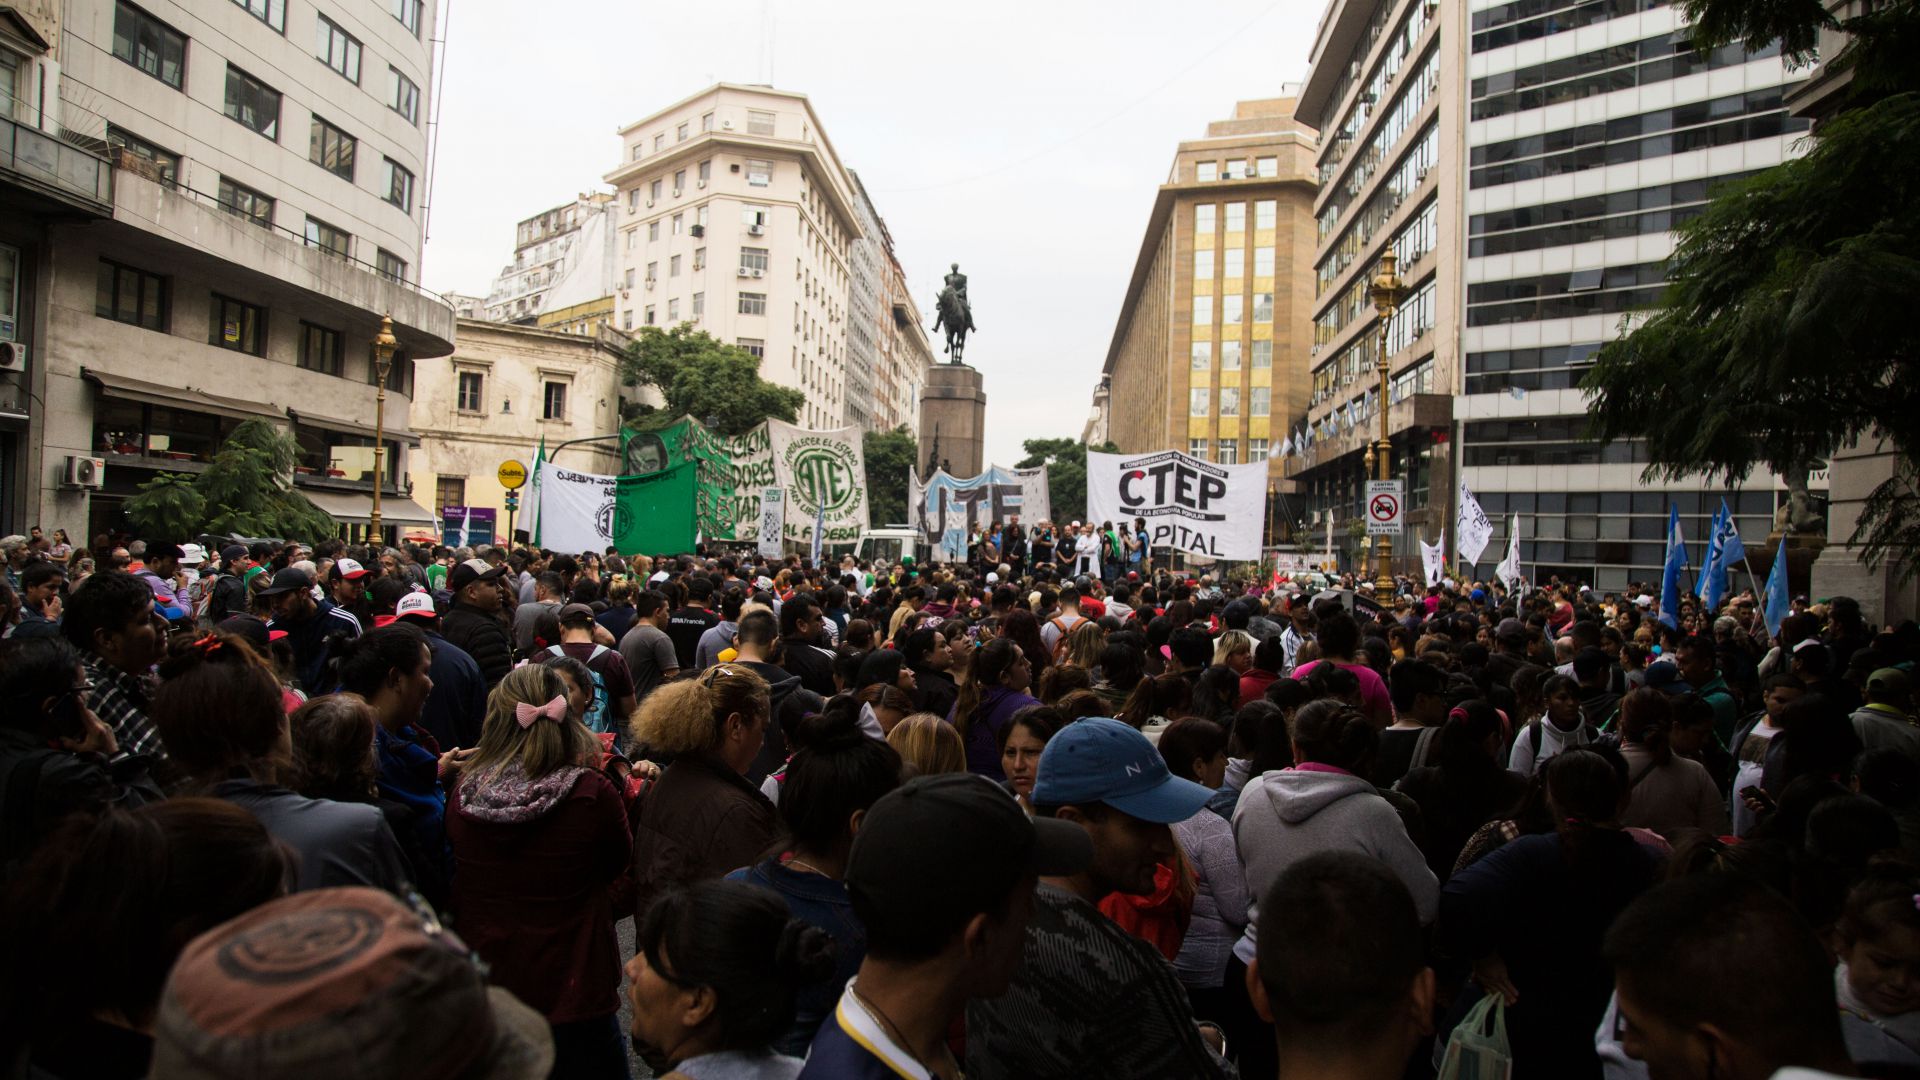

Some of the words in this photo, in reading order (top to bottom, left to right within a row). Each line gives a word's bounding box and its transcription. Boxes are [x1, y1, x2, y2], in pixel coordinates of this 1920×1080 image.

[822, 438, 833, 447] EL
[834, 441, 859, 467] ESTADO
[1173, 453, 1181, 461] DE
[1181, 456, 1226, 478] TRABAJADORES
[798, 454, 846, 506] ATE
[1118, 462, 1227, 511] CTEP
[1135, 508, 1144, 516] DE
[1144, 508, 1152, 516] LA
[1181, 510, 1206, 520] POPULAR
